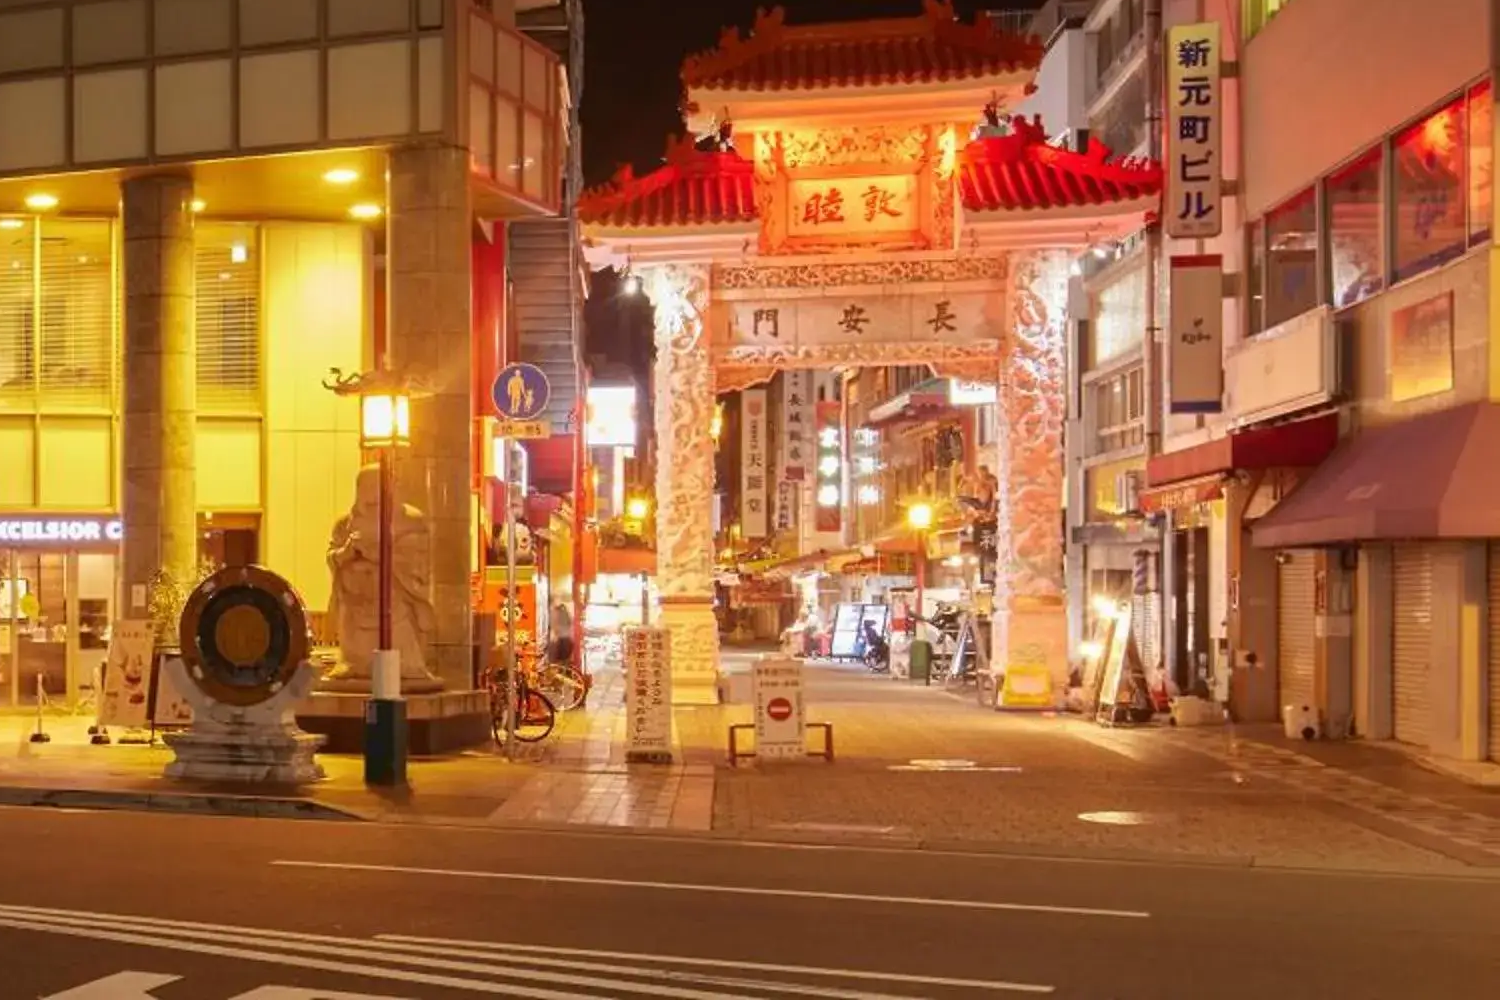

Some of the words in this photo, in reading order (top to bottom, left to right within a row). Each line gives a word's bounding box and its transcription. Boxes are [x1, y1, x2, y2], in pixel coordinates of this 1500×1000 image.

[1178, 39, 1214, 219] 新元町ビル
